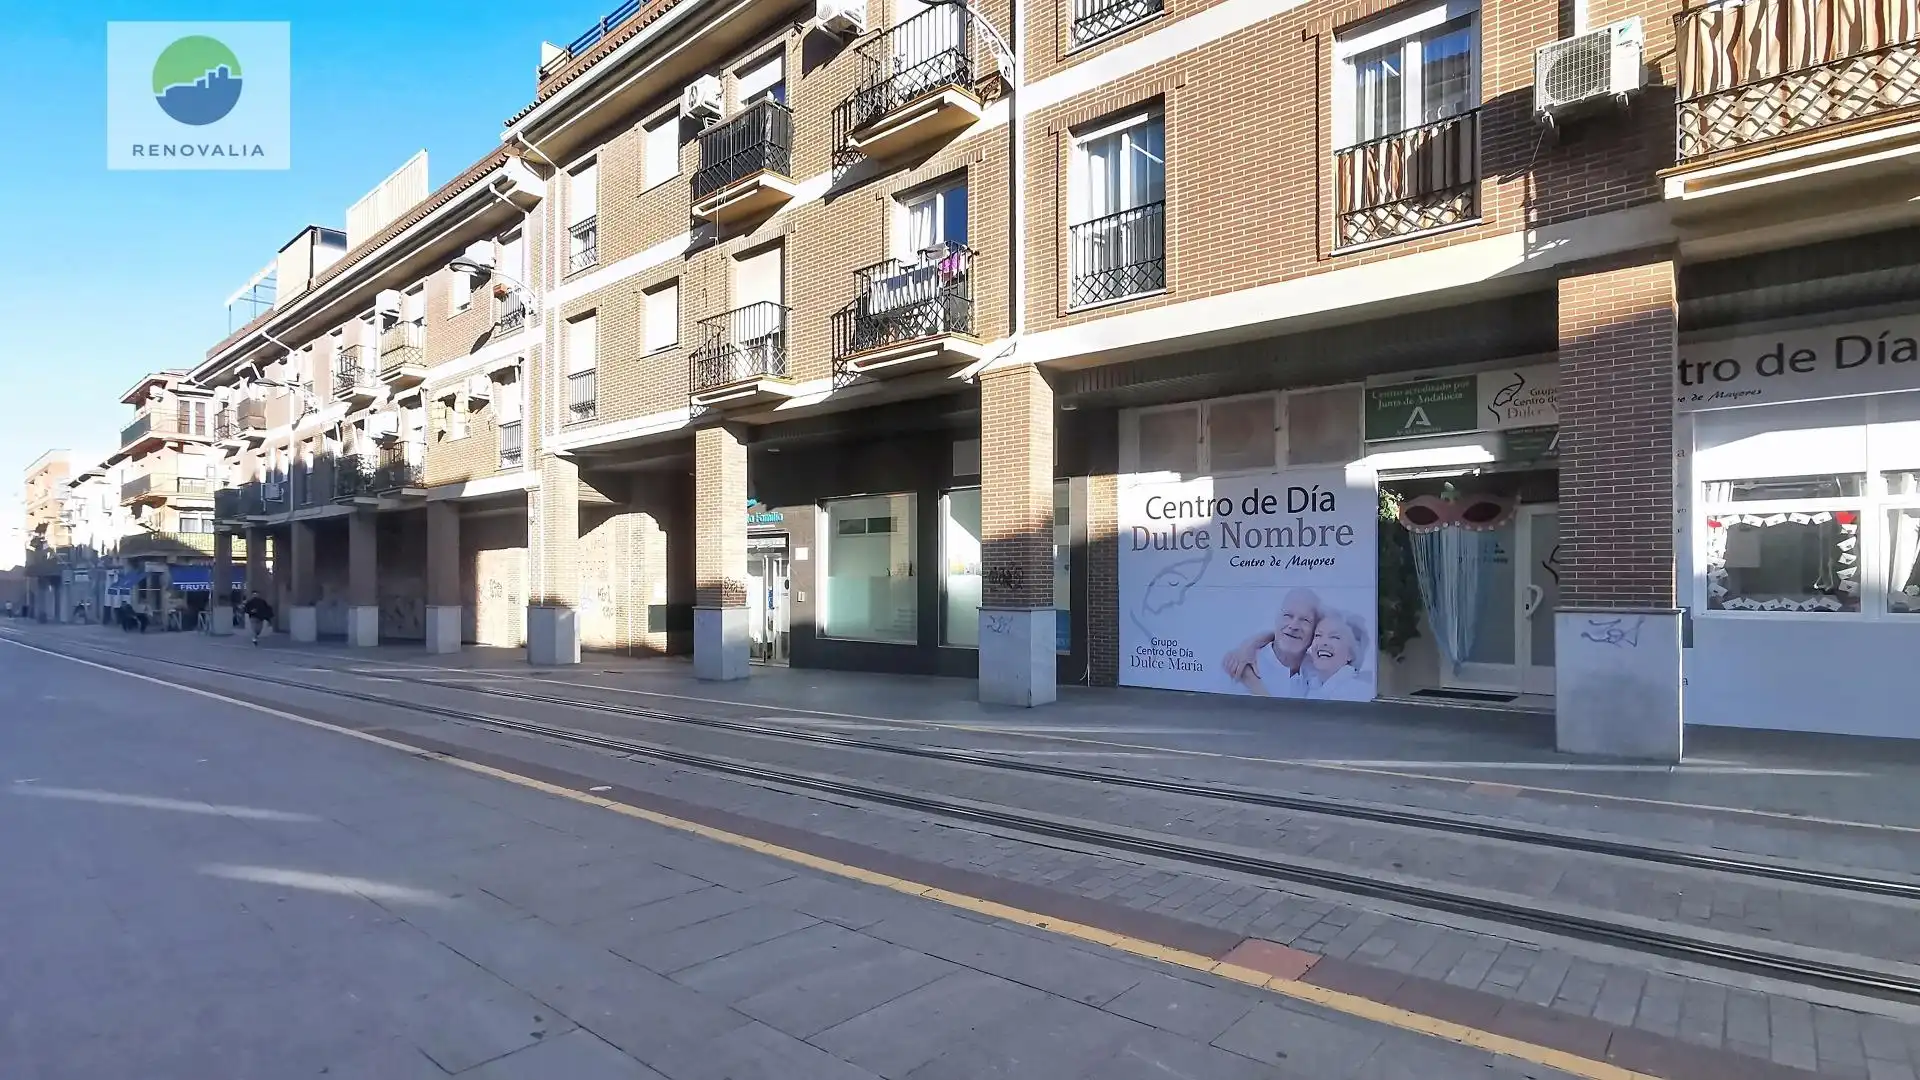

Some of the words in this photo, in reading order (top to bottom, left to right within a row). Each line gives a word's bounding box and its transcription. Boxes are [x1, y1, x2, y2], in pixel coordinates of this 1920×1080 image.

[1755, 342, 1817, 377] de
[1835, 330, 1919, 370] Día
[1372, 389, 1403, 400] Centro
[1405, 382, 1452, 395] acreditado
[1692, 392, 1704, 402] de
[1708, 389, 1762, 402] Mayores
[1377, 399, 1402, 411] Junta
[1403, 397, 1413, 405] de
[1513, 397, 1545, 407] Centro
[1146, 496, 1233, 520] Centro
[1242, 488, 1278, 515] de
[1287, 485, 1336, 514] Día
[1132, 524, 1210, 551] Dulce
[1220, 518, 1354, 549] Nombre
[1229, 555, 1266, 568] Centro
[1269, 555, 1281, 567] de
[1285, 555, 1336, 570] Mayores
[1151, 637, 1178, 648] Grupo
[1136, 646, 1164, 656] Centro
[1166, 647, 1178, 657] de
[1130, 655, 1164, 669] Dulce
[1168, 657, 1203, 671] María
